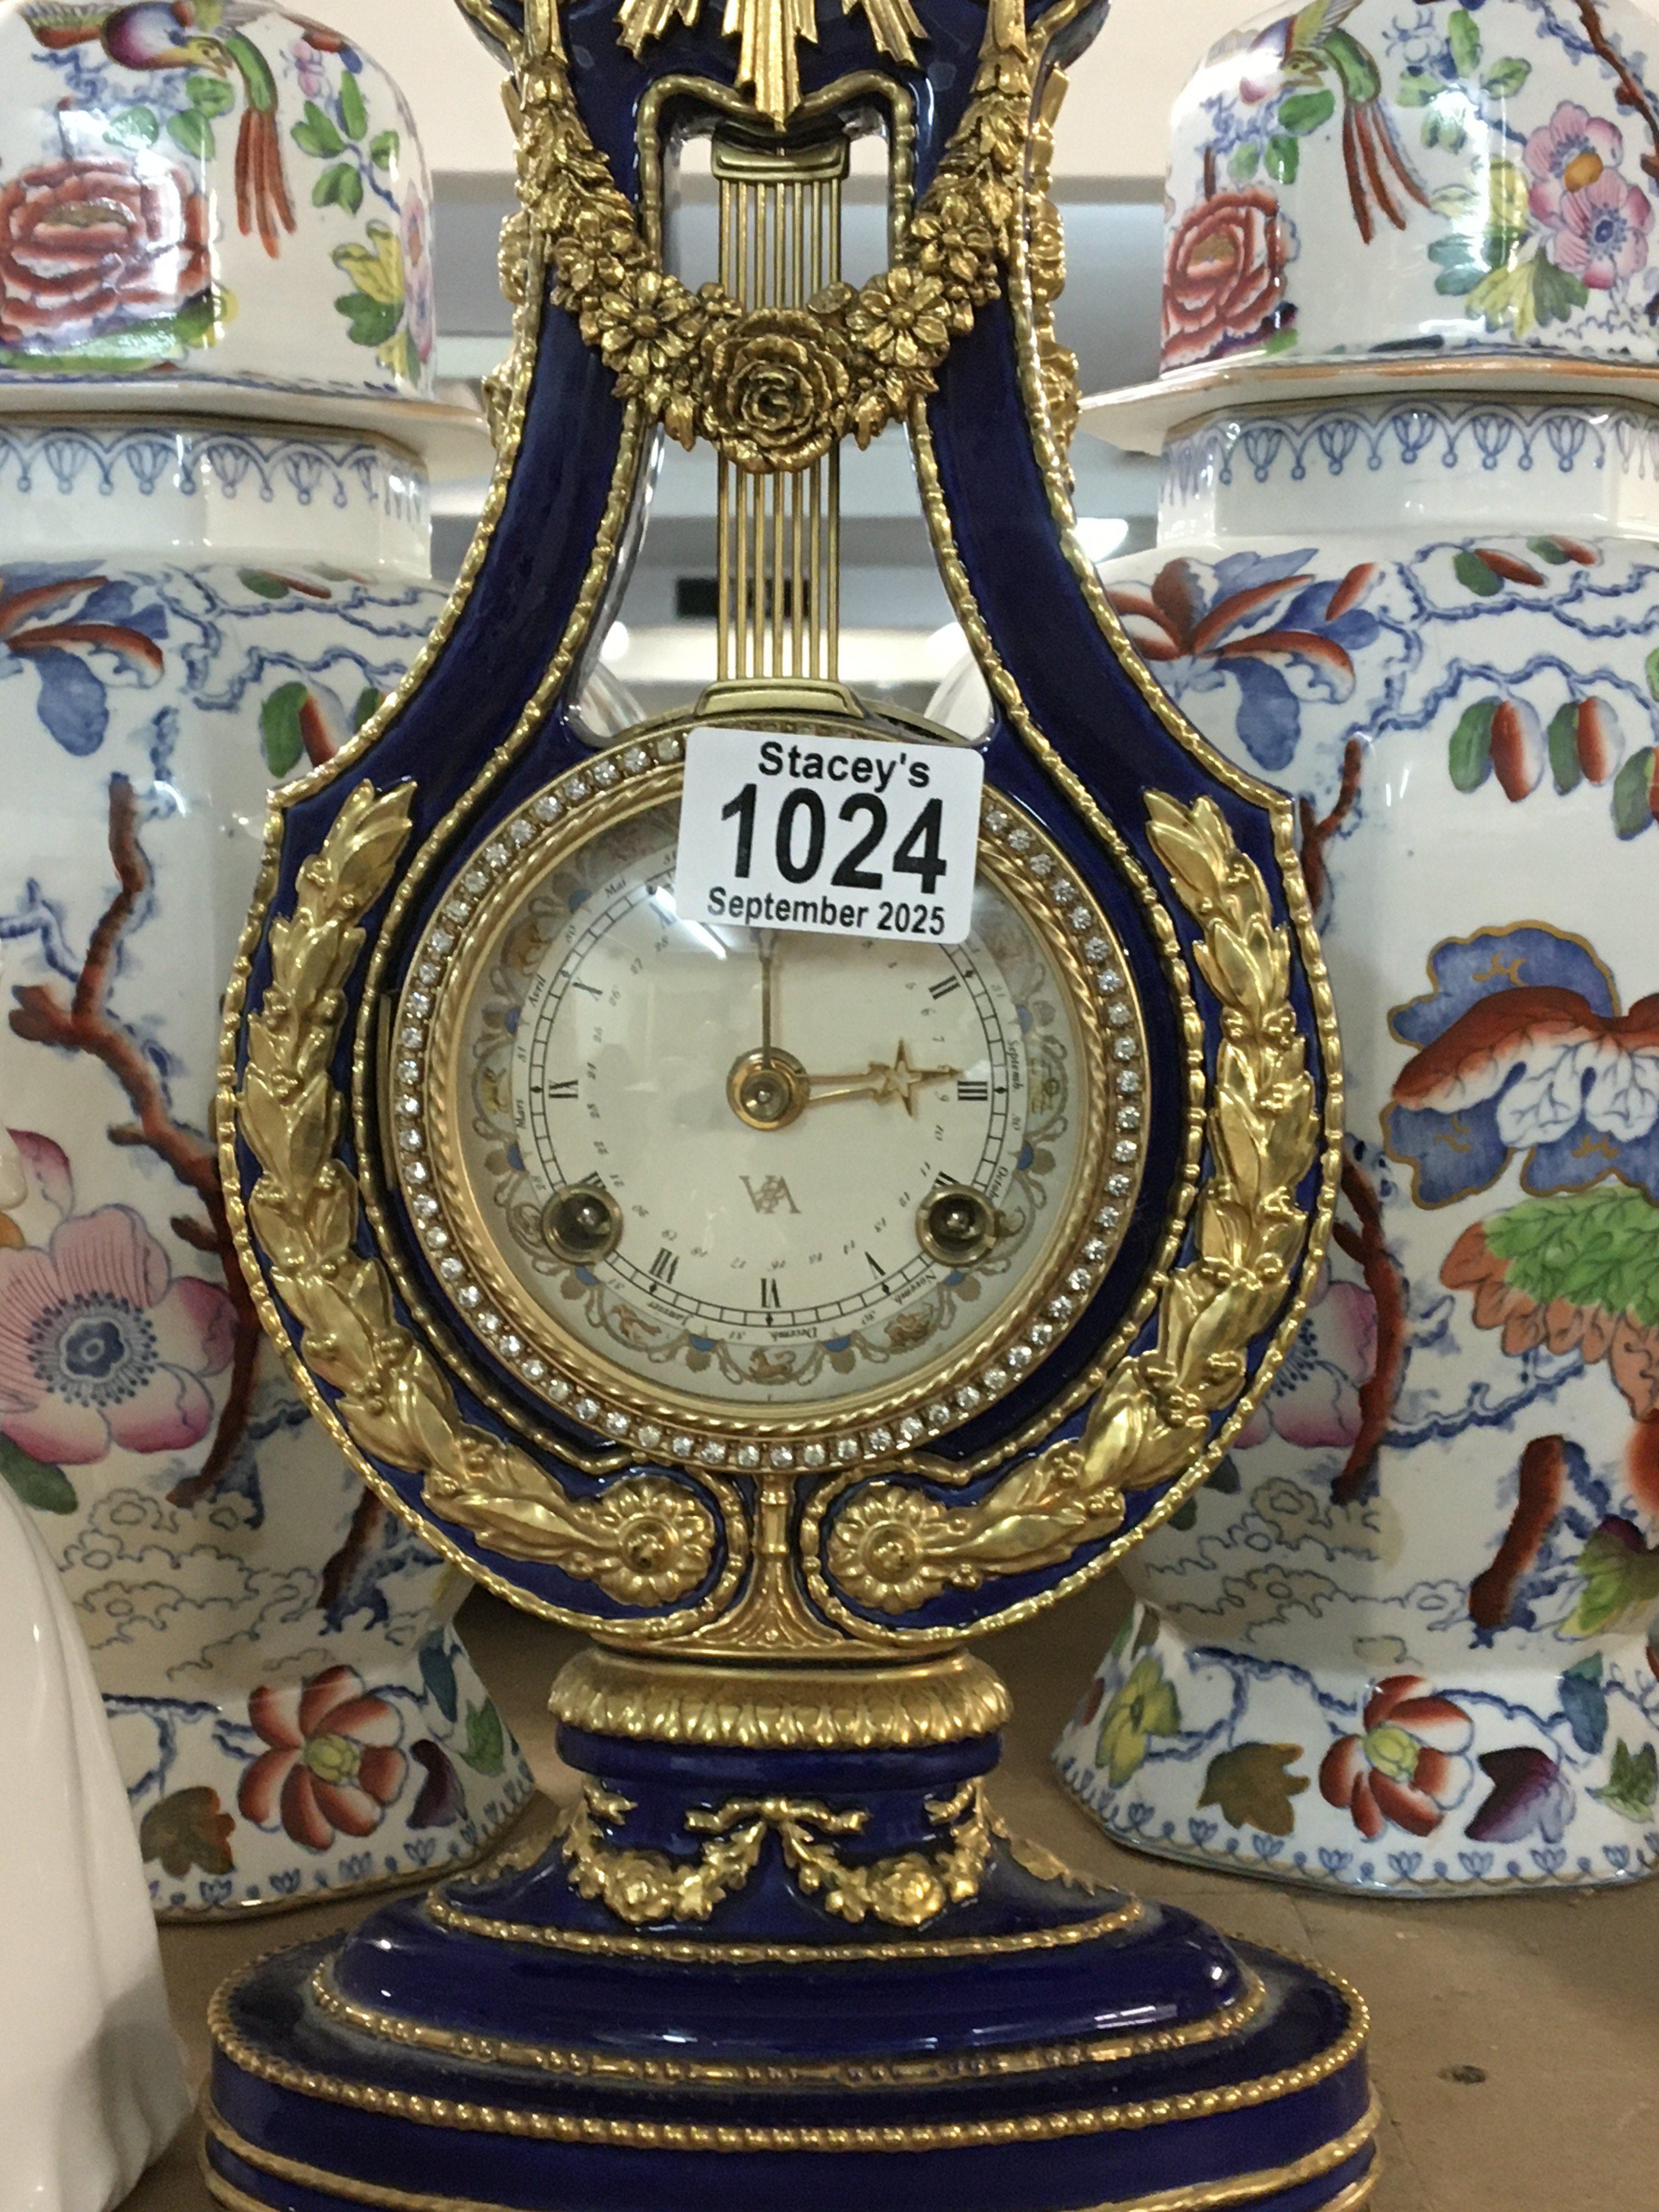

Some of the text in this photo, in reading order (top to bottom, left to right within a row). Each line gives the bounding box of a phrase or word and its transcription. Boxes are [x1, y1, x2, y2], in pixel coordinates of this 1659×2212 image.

[758, 741, 930, 793] Stacey's
[721, 783, 947, 895] 1024
[708, 886, 945, 935] September 2025
[928, 974, 961, 1001] II
[957, 1081, 988, 1101] III
[760, 1277, 781, 1308] VI
